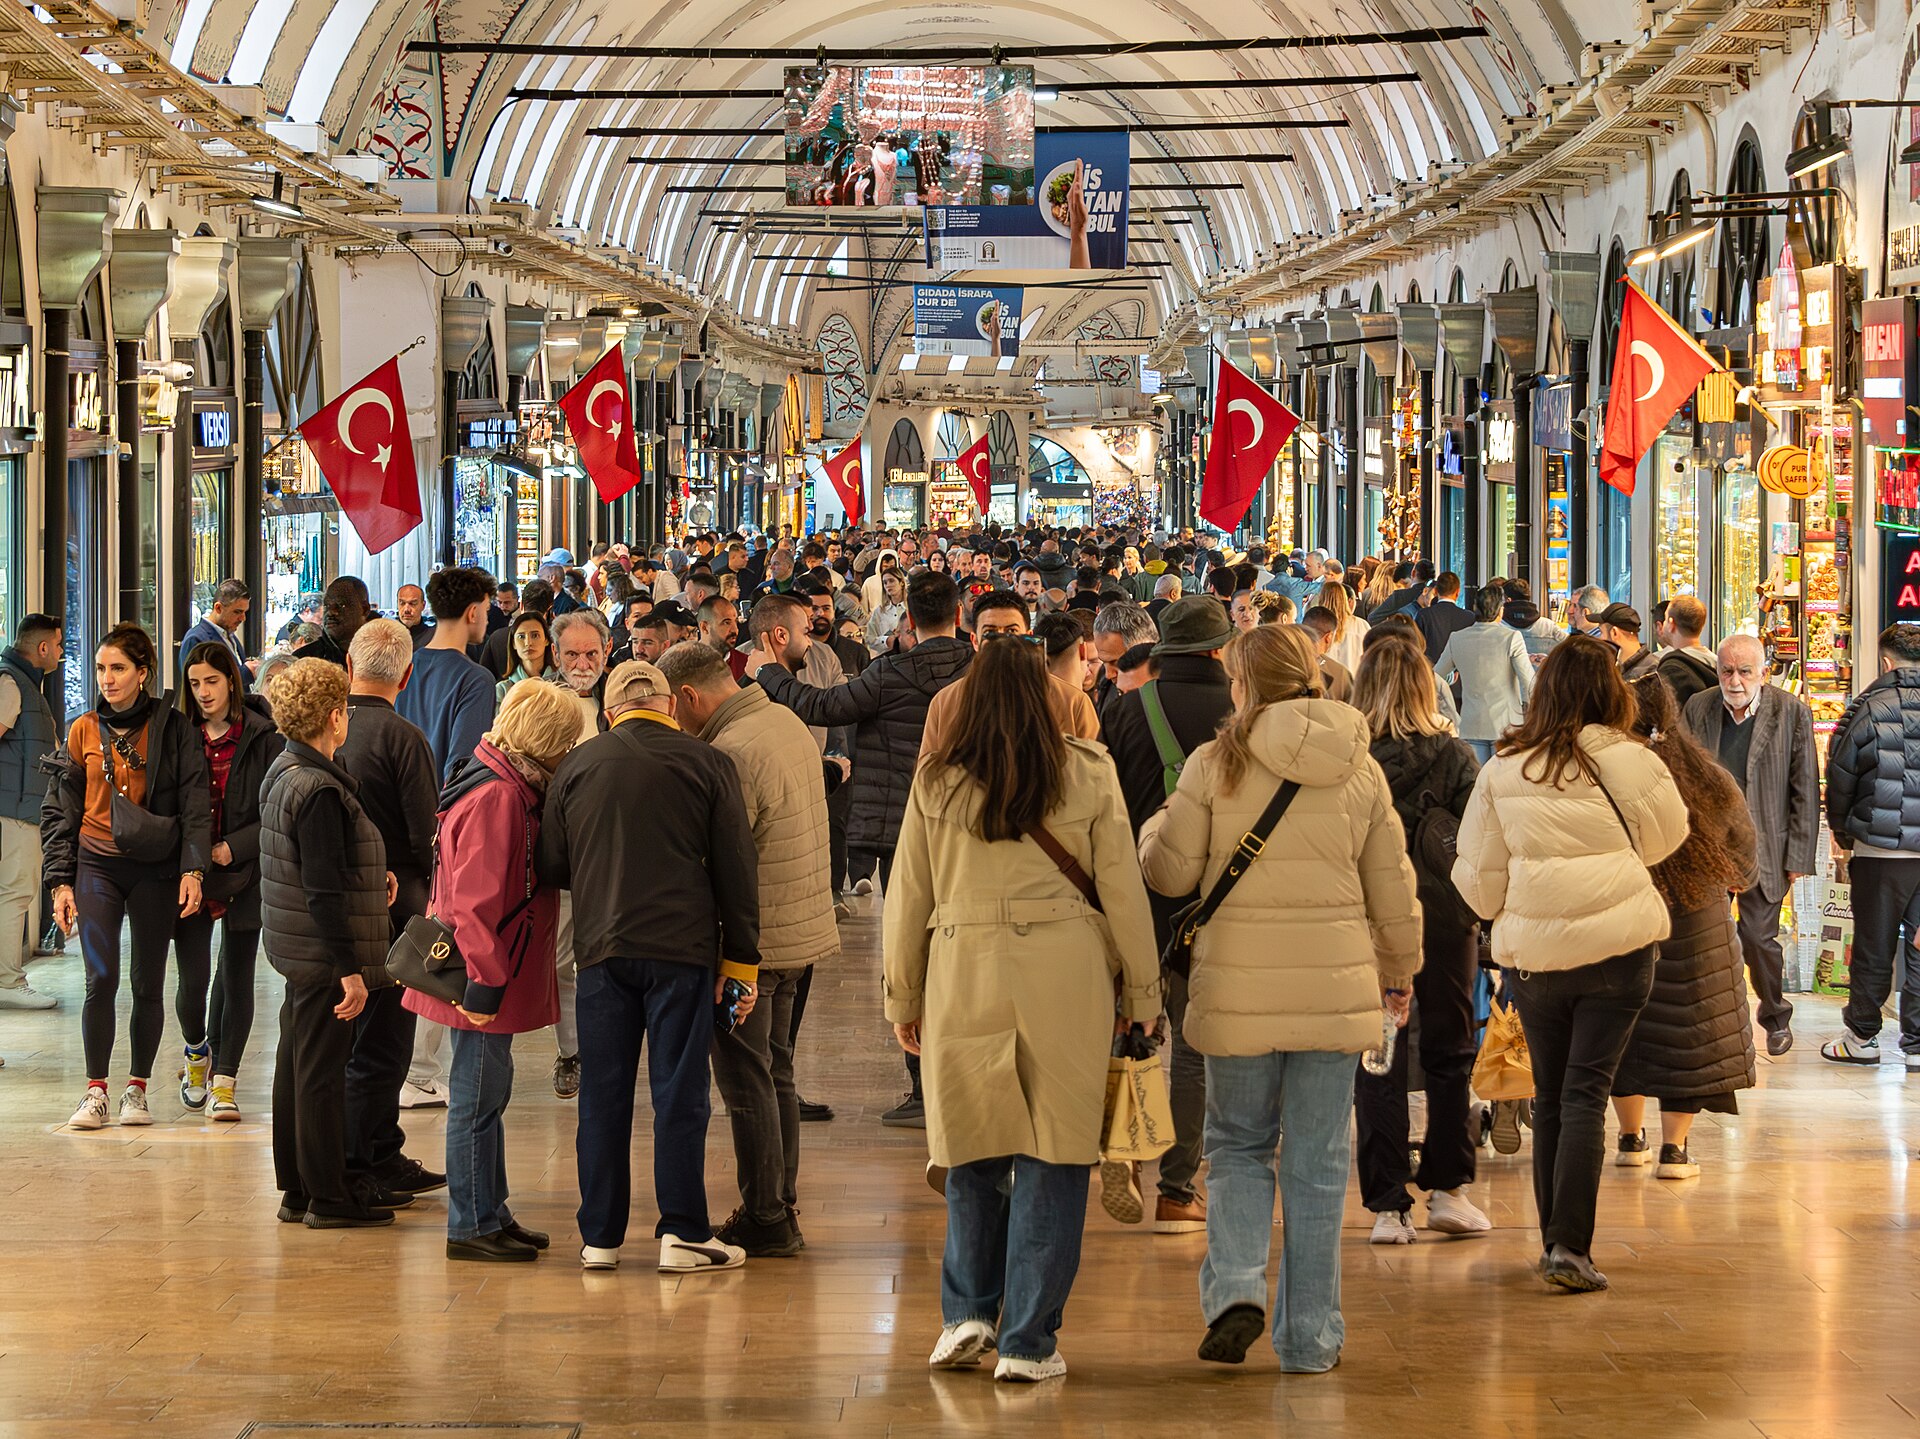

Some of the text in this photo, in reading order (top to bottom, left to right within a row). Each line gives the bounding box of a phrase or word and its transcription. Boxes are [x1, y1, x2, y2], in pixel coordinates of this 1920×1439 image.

[1084, 191, 1122, 213] TAN
[1086, 214, 1117, 233] BUL
[918, 288, 994, 298] GIDADA İSRAFA
[917, 298, 940, 306] DUR
[1000, 316, 1019, 328] TAN
[1864, 323, 1901, 361] HASAN
